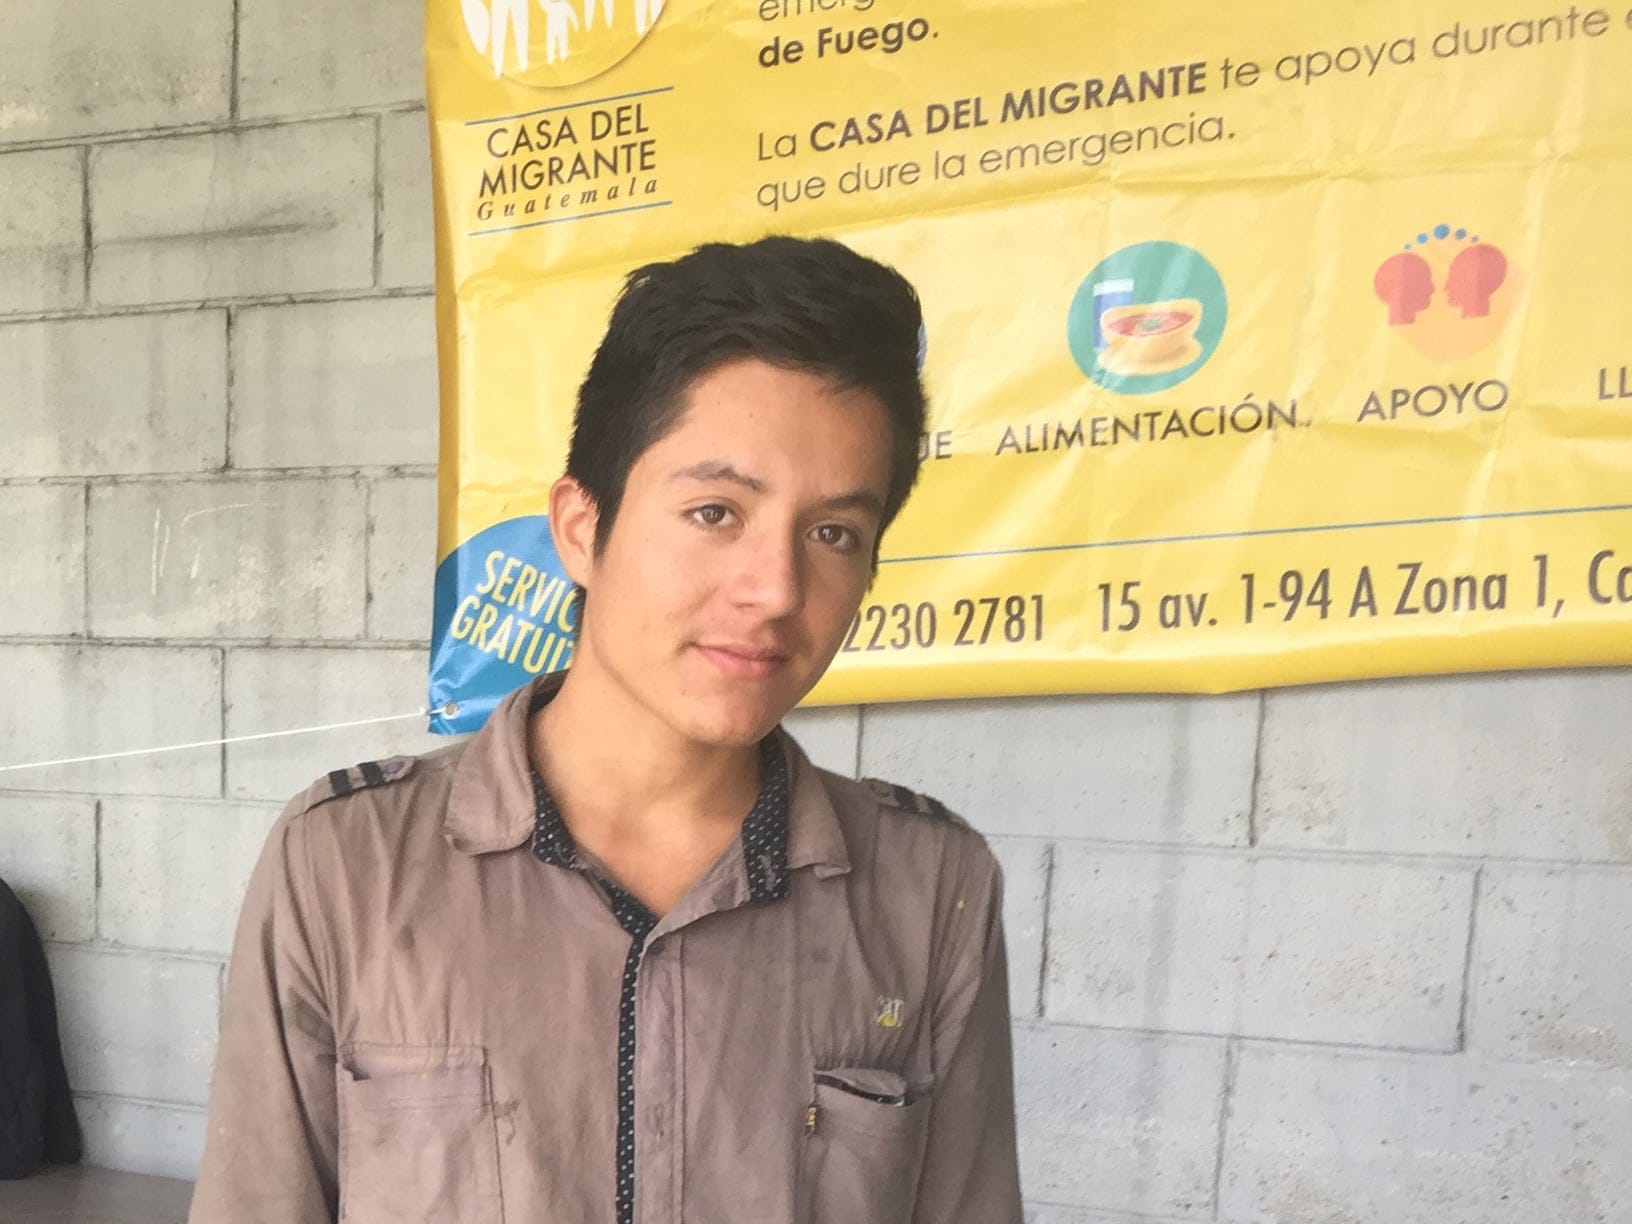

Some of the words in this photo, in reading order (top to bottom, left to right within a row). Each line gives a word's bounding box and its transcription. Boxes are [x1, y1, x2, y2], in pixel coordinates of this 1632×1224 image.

[758, 36, 804, 68] de
[818, 18, 939, 58] Fuego.
[759, 131, 797, 161] La
[810, 111, 911, 153] CASA
[926, 96, 988, 135] DEL
[1000, 62, 1207, 124] MIGRANTE
[1221, 56, 1260, 90] te
[1275, 35, 1416, 84] apoya
[1431, 6, 1610, 59] durante
[487, 116, 576, 160] CASA
[591, 104, 649, 141] DEL
[479, 140, 657, 199] MIGRANTE
[757, 175, 826, 212] que
[839, 148, 920, 193] dure
[935, 145, 966, 180] la
[980, 111, 1236, 173] emergencia.
[477, 176, 658, 221] Guatemala
[1358, 380, 1510, 423] APOYO
[1598, 366, 1632, 400] LL
[841, 601, 937, 653] 2230
[954, 594, 1044, 646] 2781
[1099, 581, 1141, 633] 15
[1158, 591, 1218, 628] av.
[1241, 568, 1332, 624] 1-94
[1348, 566, 1377, 618] A
[1394, 562, 1508, 615] Zona
[1533, 554, 1565, 618] 1,
